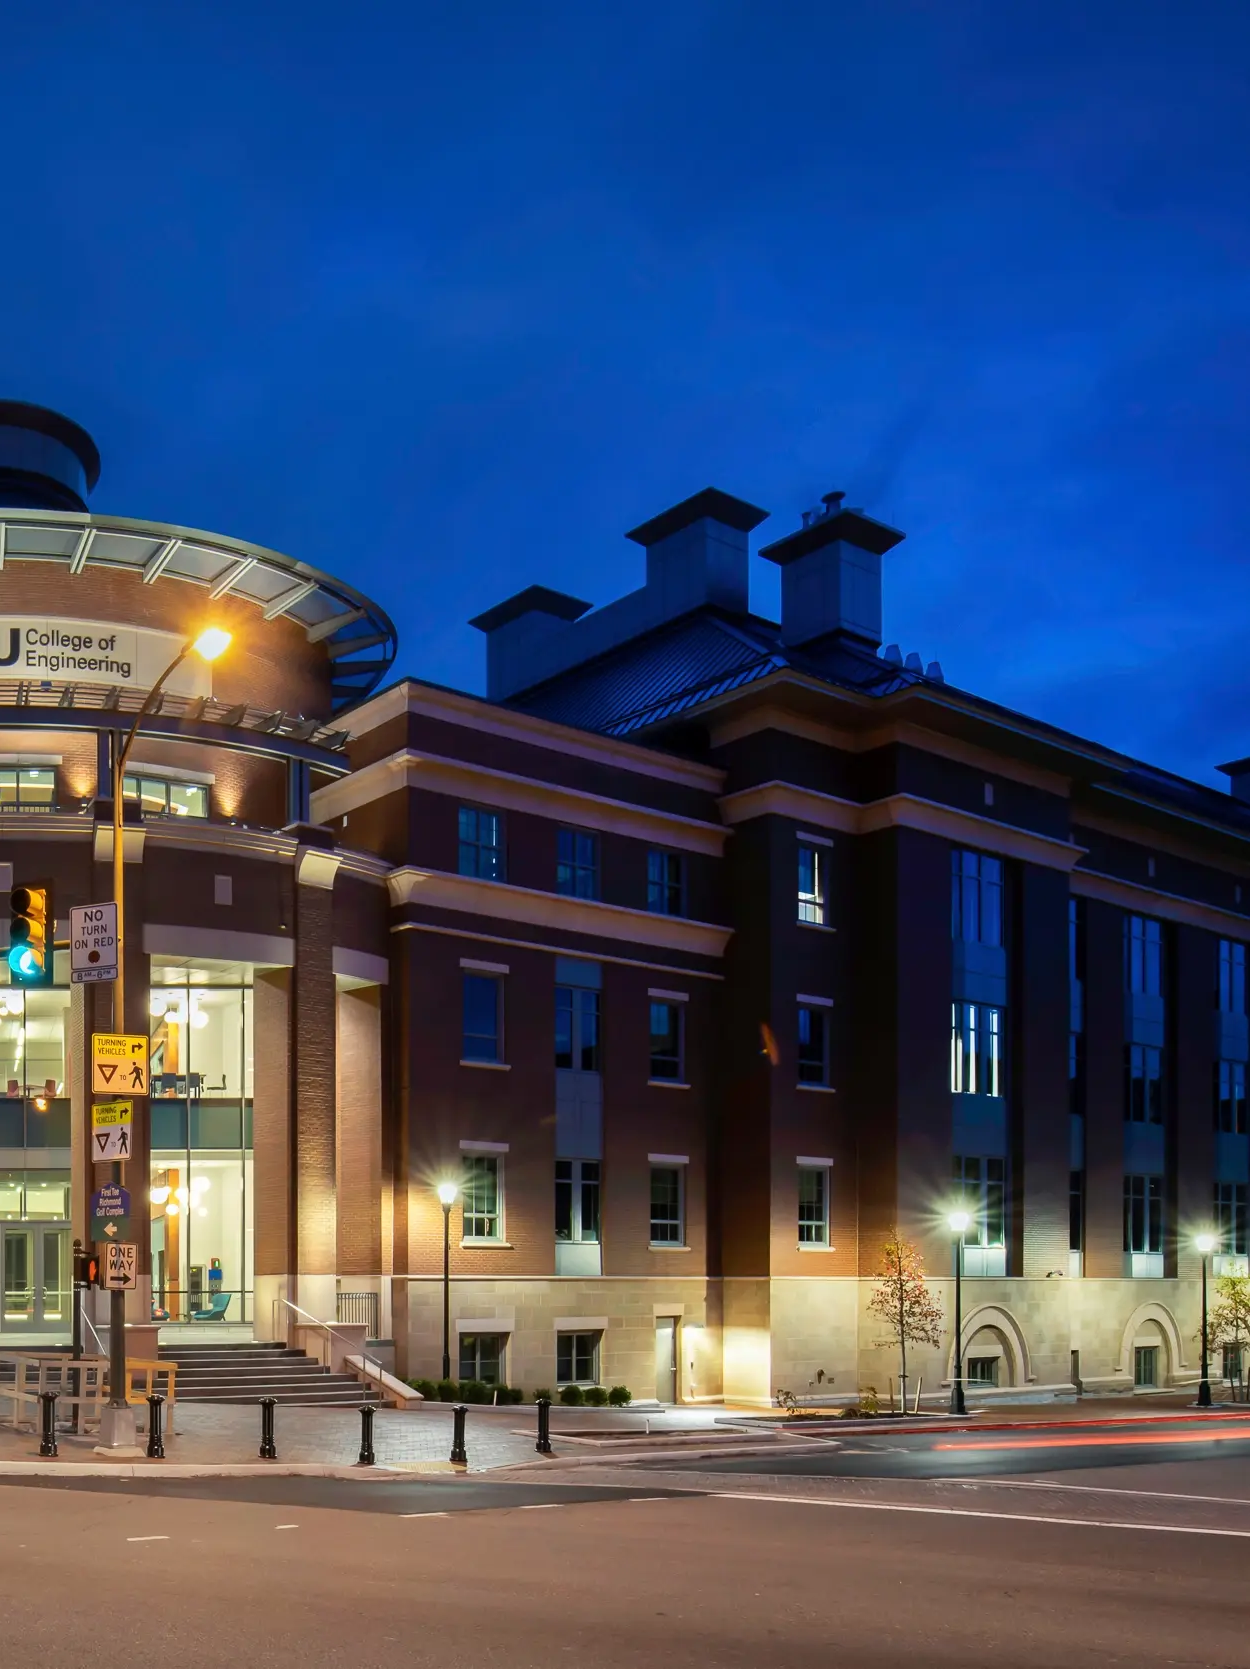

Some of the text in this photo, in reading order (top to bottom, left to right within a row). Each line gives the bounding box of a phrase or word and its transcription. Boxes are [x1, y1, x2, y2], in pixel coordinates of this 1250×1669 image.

[26, 628, 116, 651] College of
[26, 650, 132, 678] Engineering
[84, 910, 103, 923] NO
[81, 924, 107, 936] TURN
[74, 937, 114, 950] ON RED
[96, 1107, 116, 1115] TURNING
[96, 1116, 116, 1124] VEHICLES
[101, 1187, 111, 1197] First
[100, 1197, 122, 1206] Richmond
[96, 1207, 124, 1217] Golf Complex
[110, 1247, 134, 1258] ONE
[110, 1260, 134, 1271] WAY
